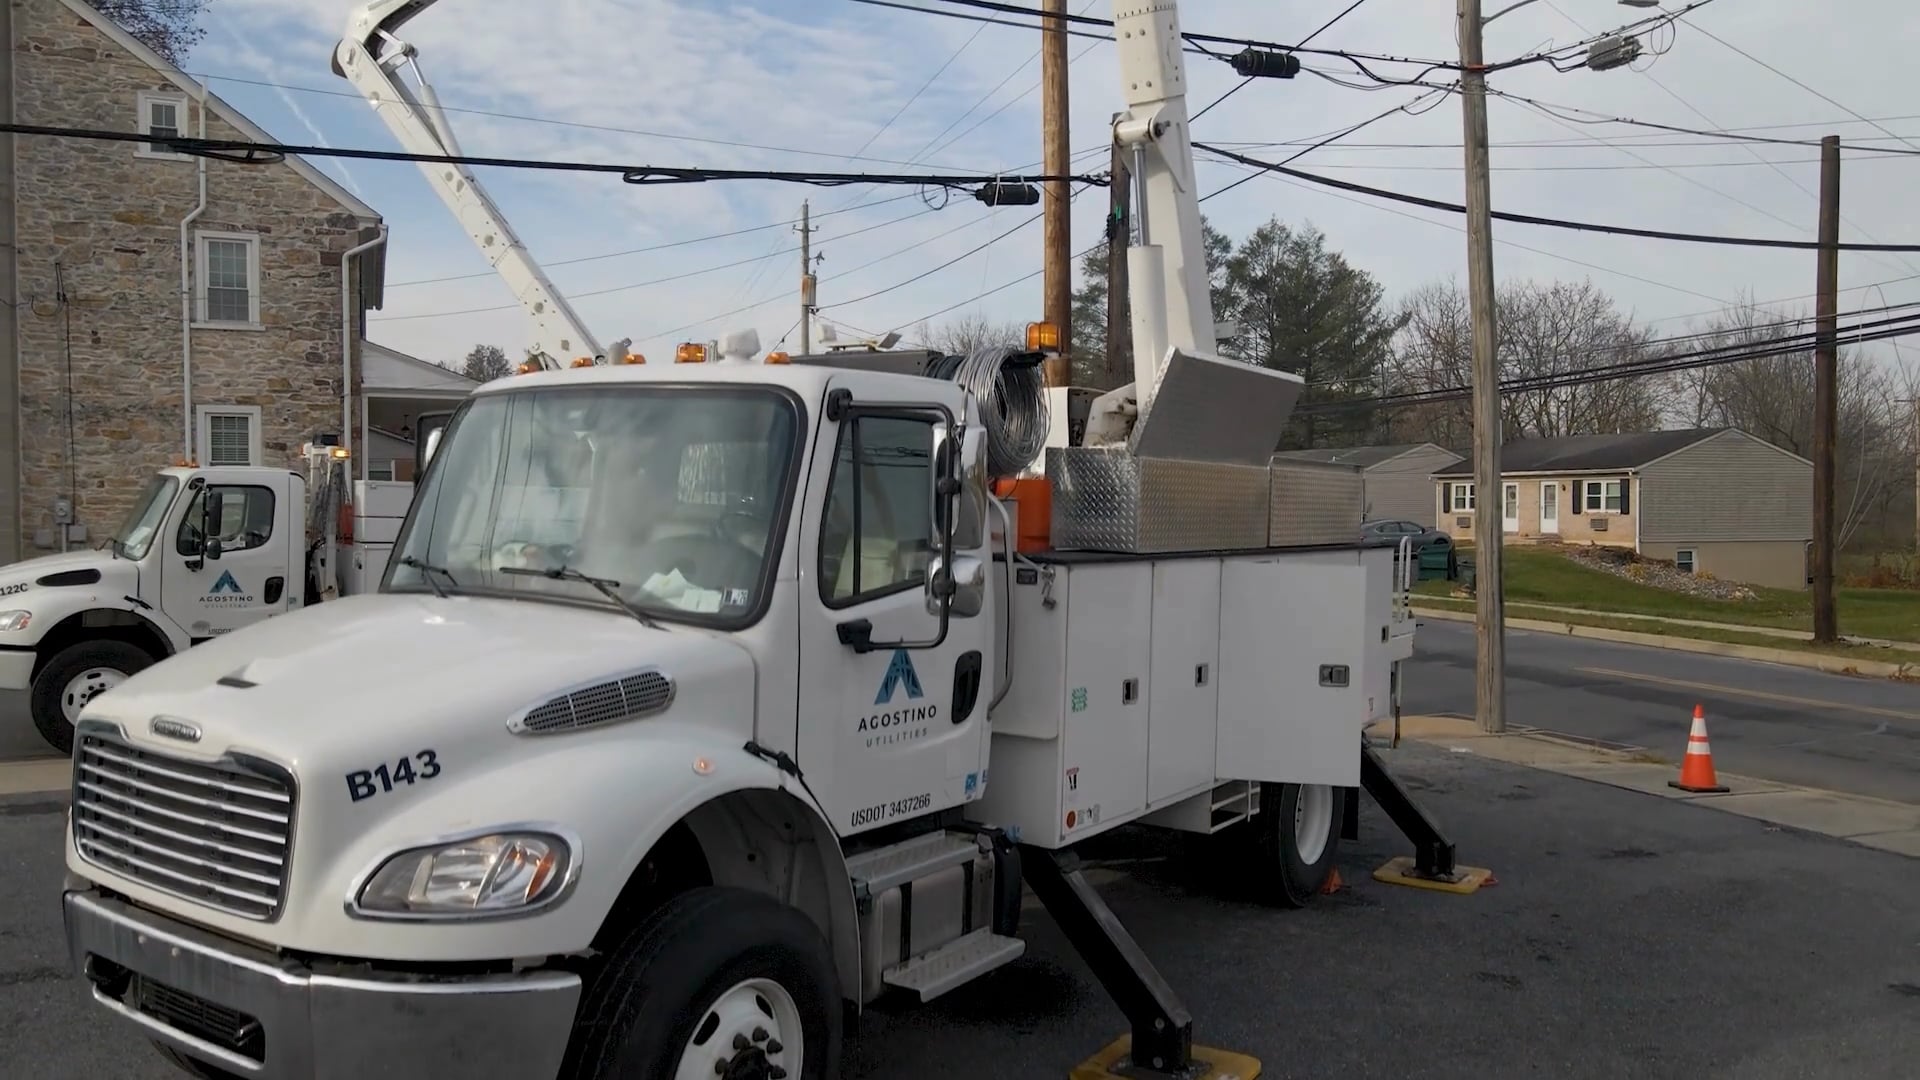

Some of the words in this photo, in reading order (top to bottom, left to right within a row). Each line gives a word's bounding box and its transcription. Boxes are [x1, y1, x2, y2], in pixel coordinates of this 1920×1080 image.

[857, 704, 938, 733] AGOSTINO
[866, 727, 928, 748] UTILITIES
[345, 748, 442, 804] B143
[851, 803, 888, 828] USDOT
[888, 792, 932, 818] 3437266
